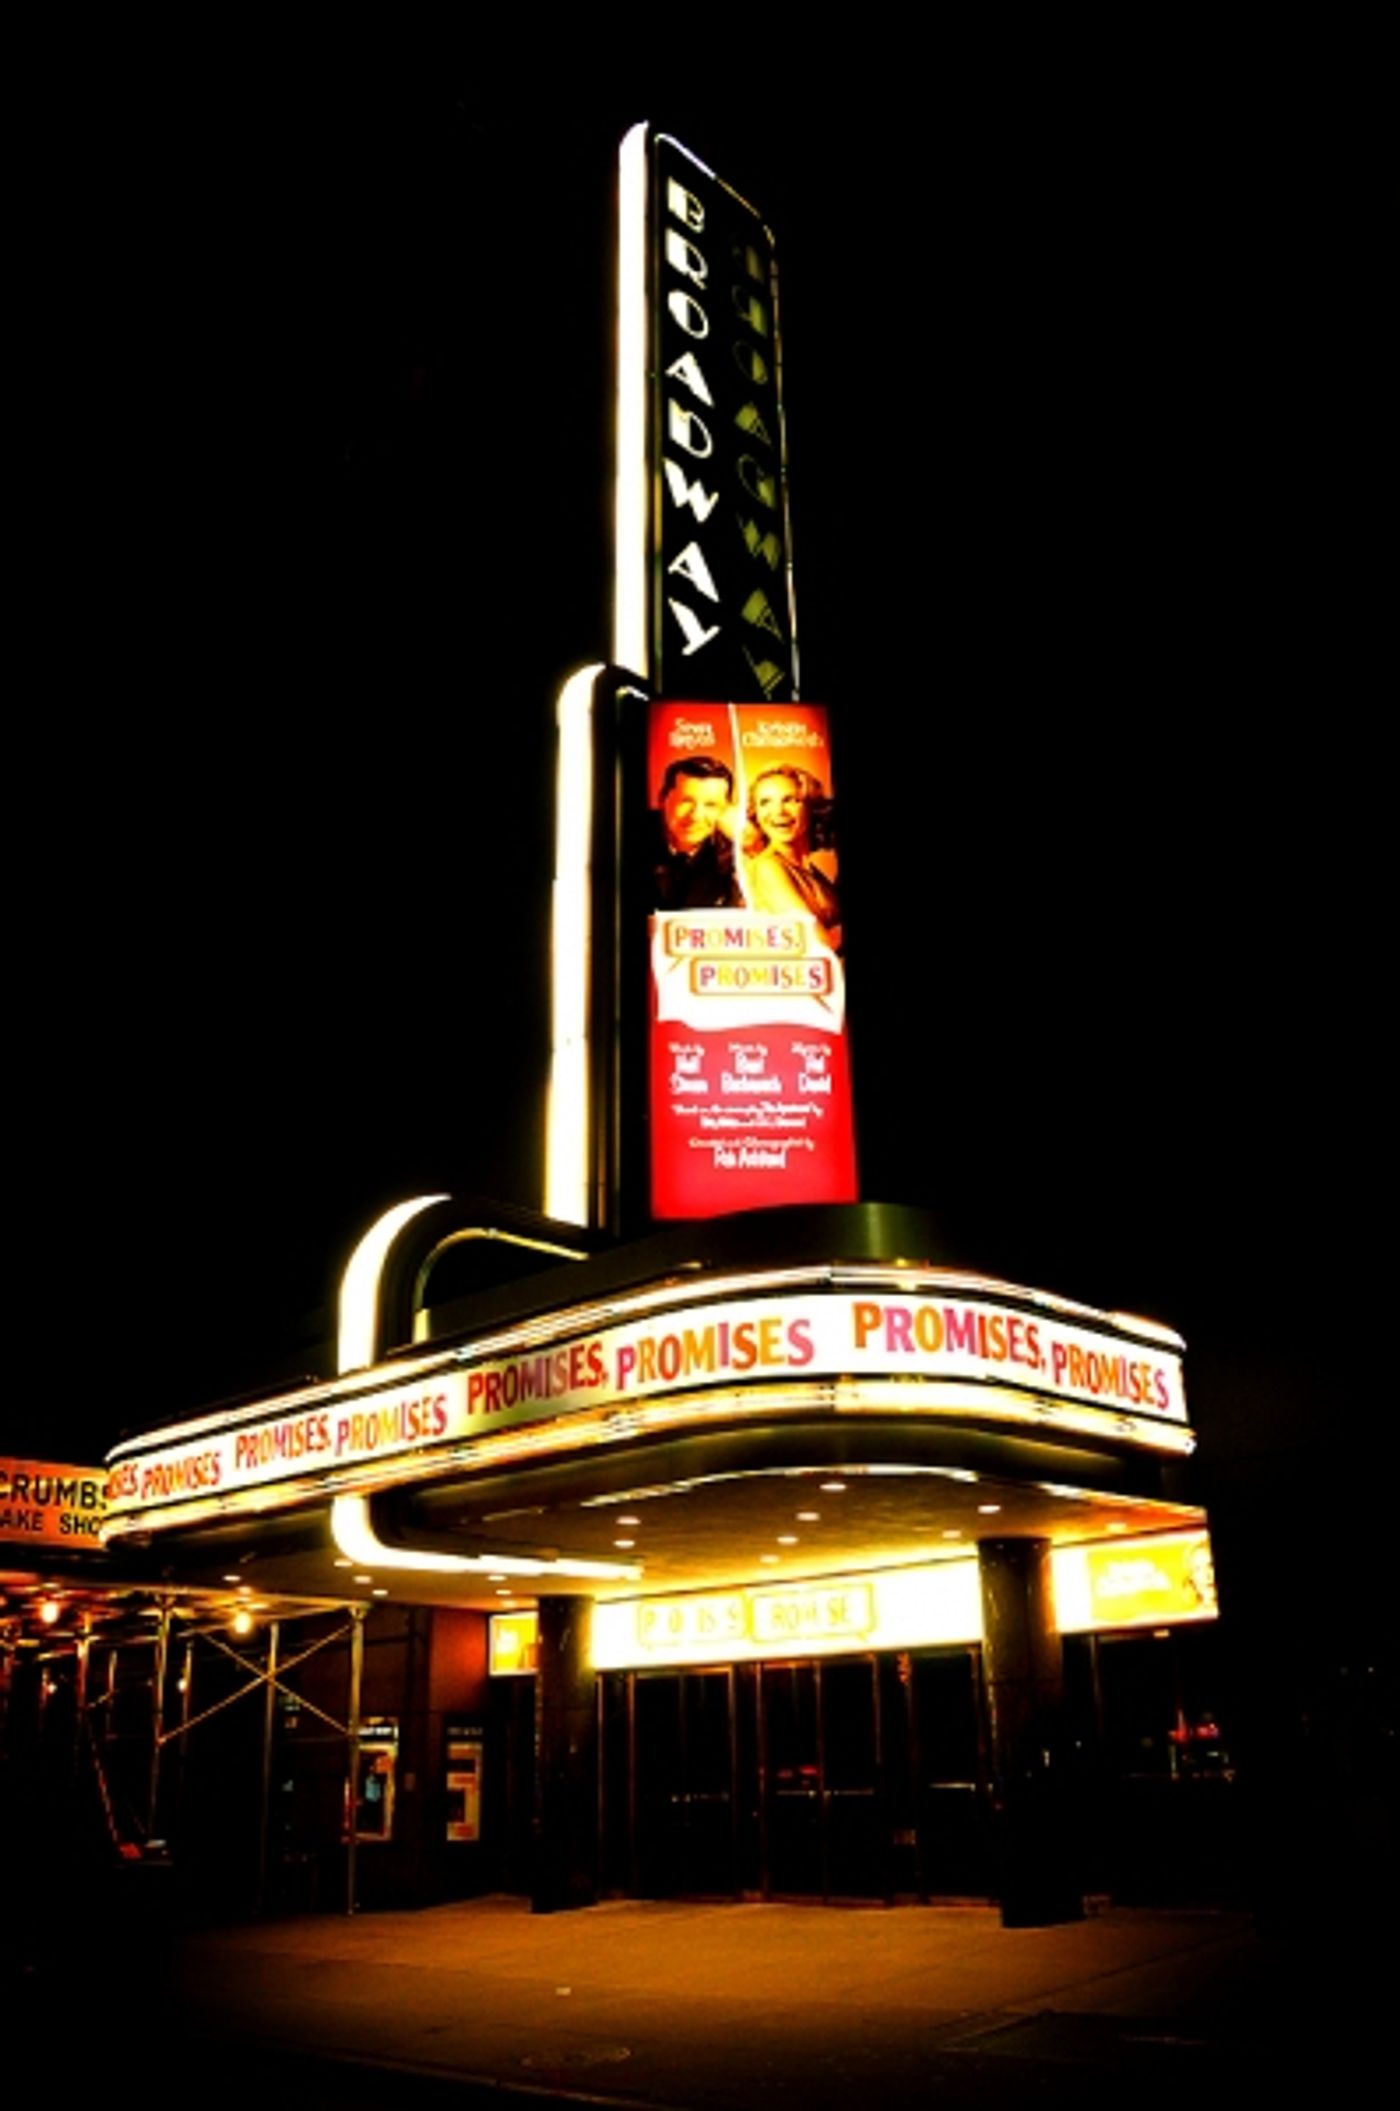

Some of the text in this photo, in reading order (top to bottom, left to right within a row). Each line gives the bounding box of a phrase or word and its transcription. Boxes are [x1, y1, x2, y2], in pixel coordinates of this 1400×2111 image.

[664, 176, 720, 656] BROADWAY
[700, 964, 823, 989] PROMISES
[615, 1317, 815, 1391] PROMISES
[852, 1301, 1169, 1410] PROMISES, PROMISES
[334, 1393, 447, 1456] PROMISES
[141, 1451, 221, 1500] PROMISES
